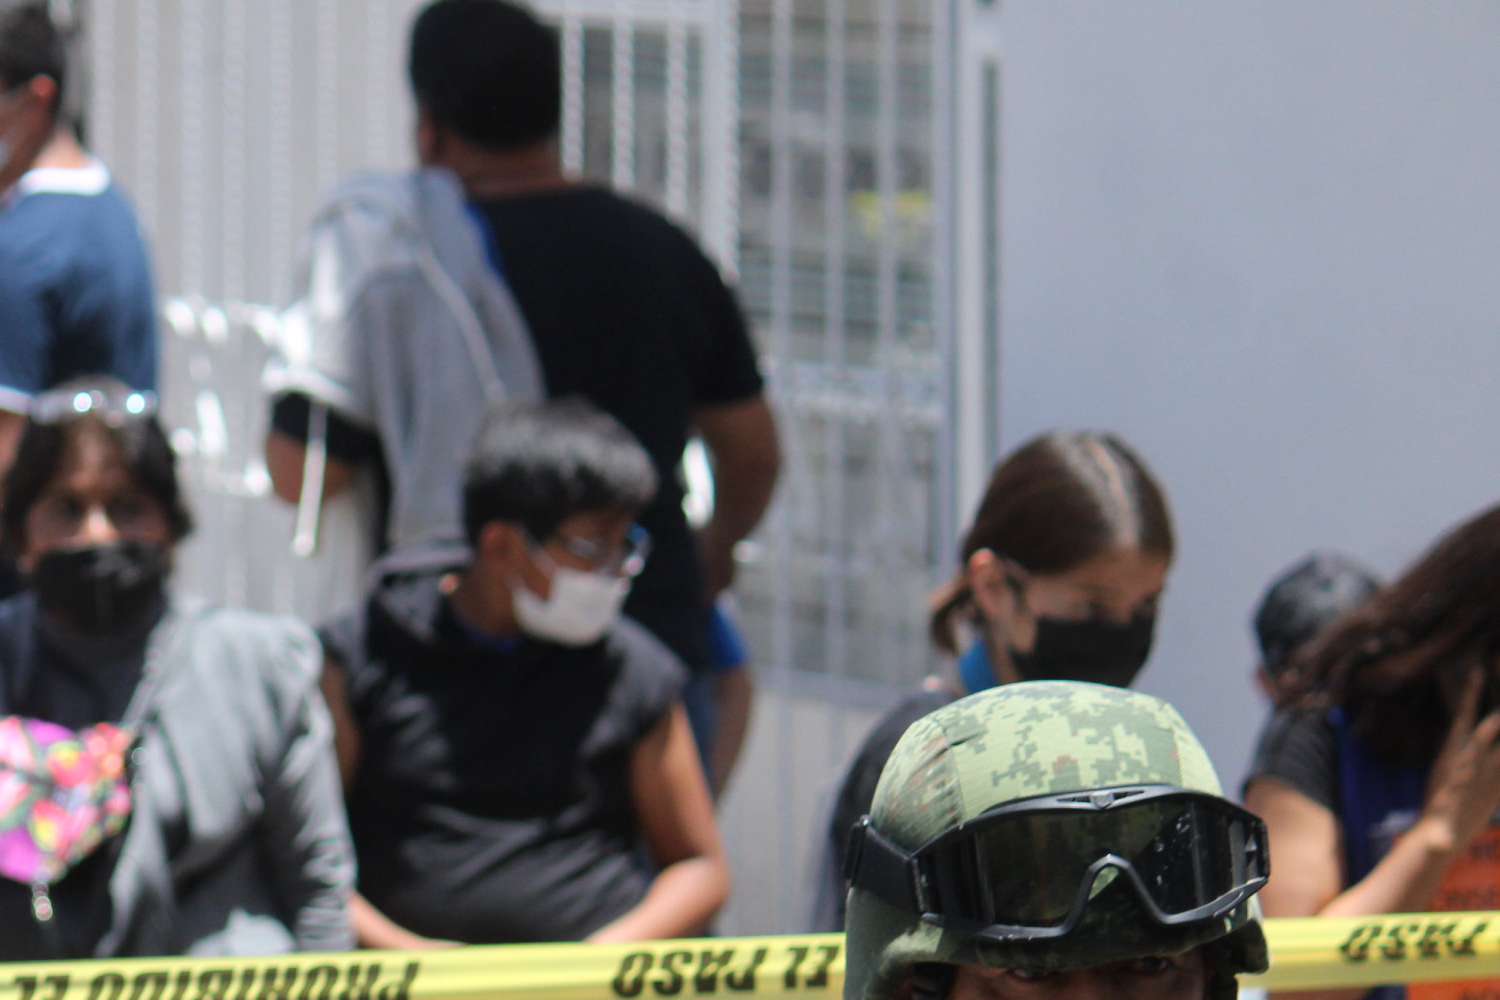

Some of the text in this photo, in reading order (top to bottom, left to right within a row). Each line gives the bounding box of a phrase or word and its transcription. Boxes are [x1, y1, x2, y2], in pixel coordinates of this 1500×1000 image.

[1338, 920, 1489, 963] PASO
[612, 945, 841, 998] EL PASO
